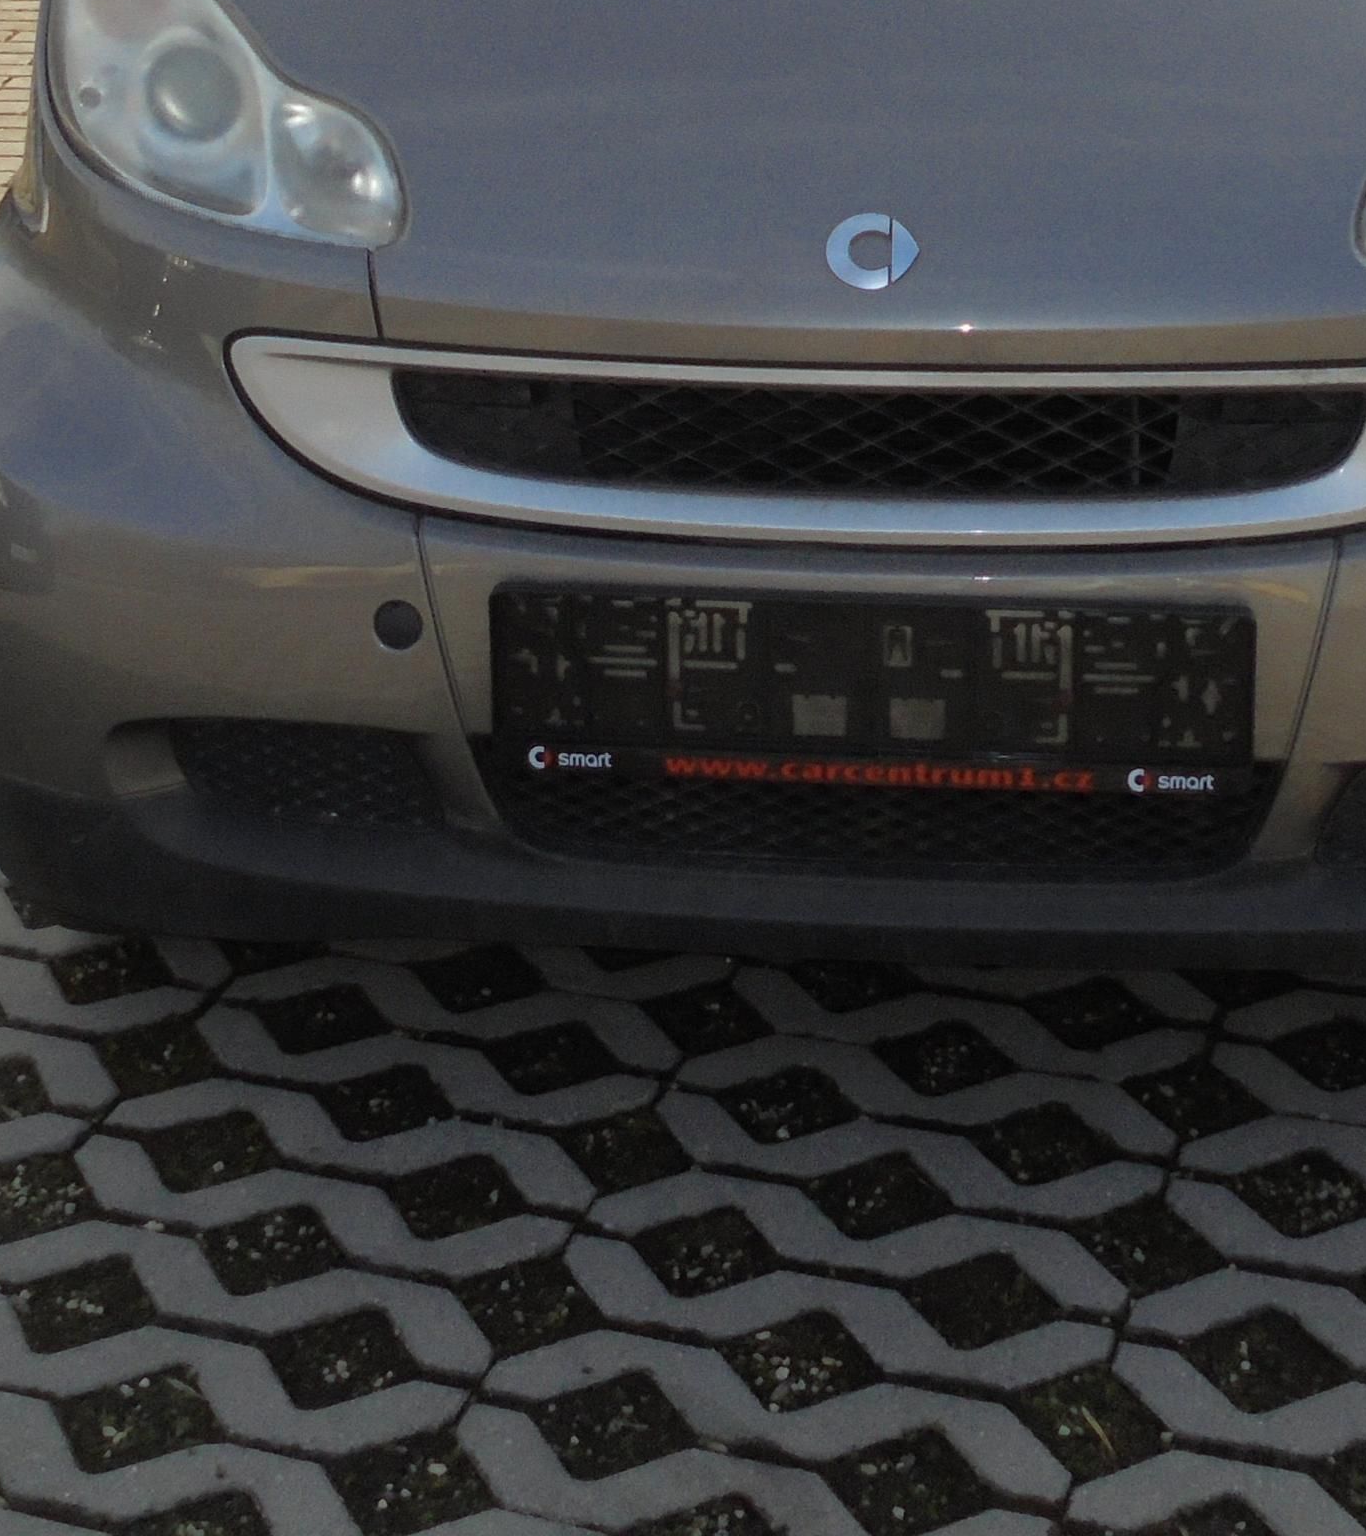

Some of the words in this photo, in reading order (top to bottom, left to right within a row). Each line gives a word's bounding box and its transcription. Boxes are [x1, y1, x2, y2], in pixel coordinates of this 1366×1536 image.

[557, 751, 612, 769] smart
[666, 755, 1094, 793] www.carcentrum1.cz
[1157, 773, 1215, 791] smart
